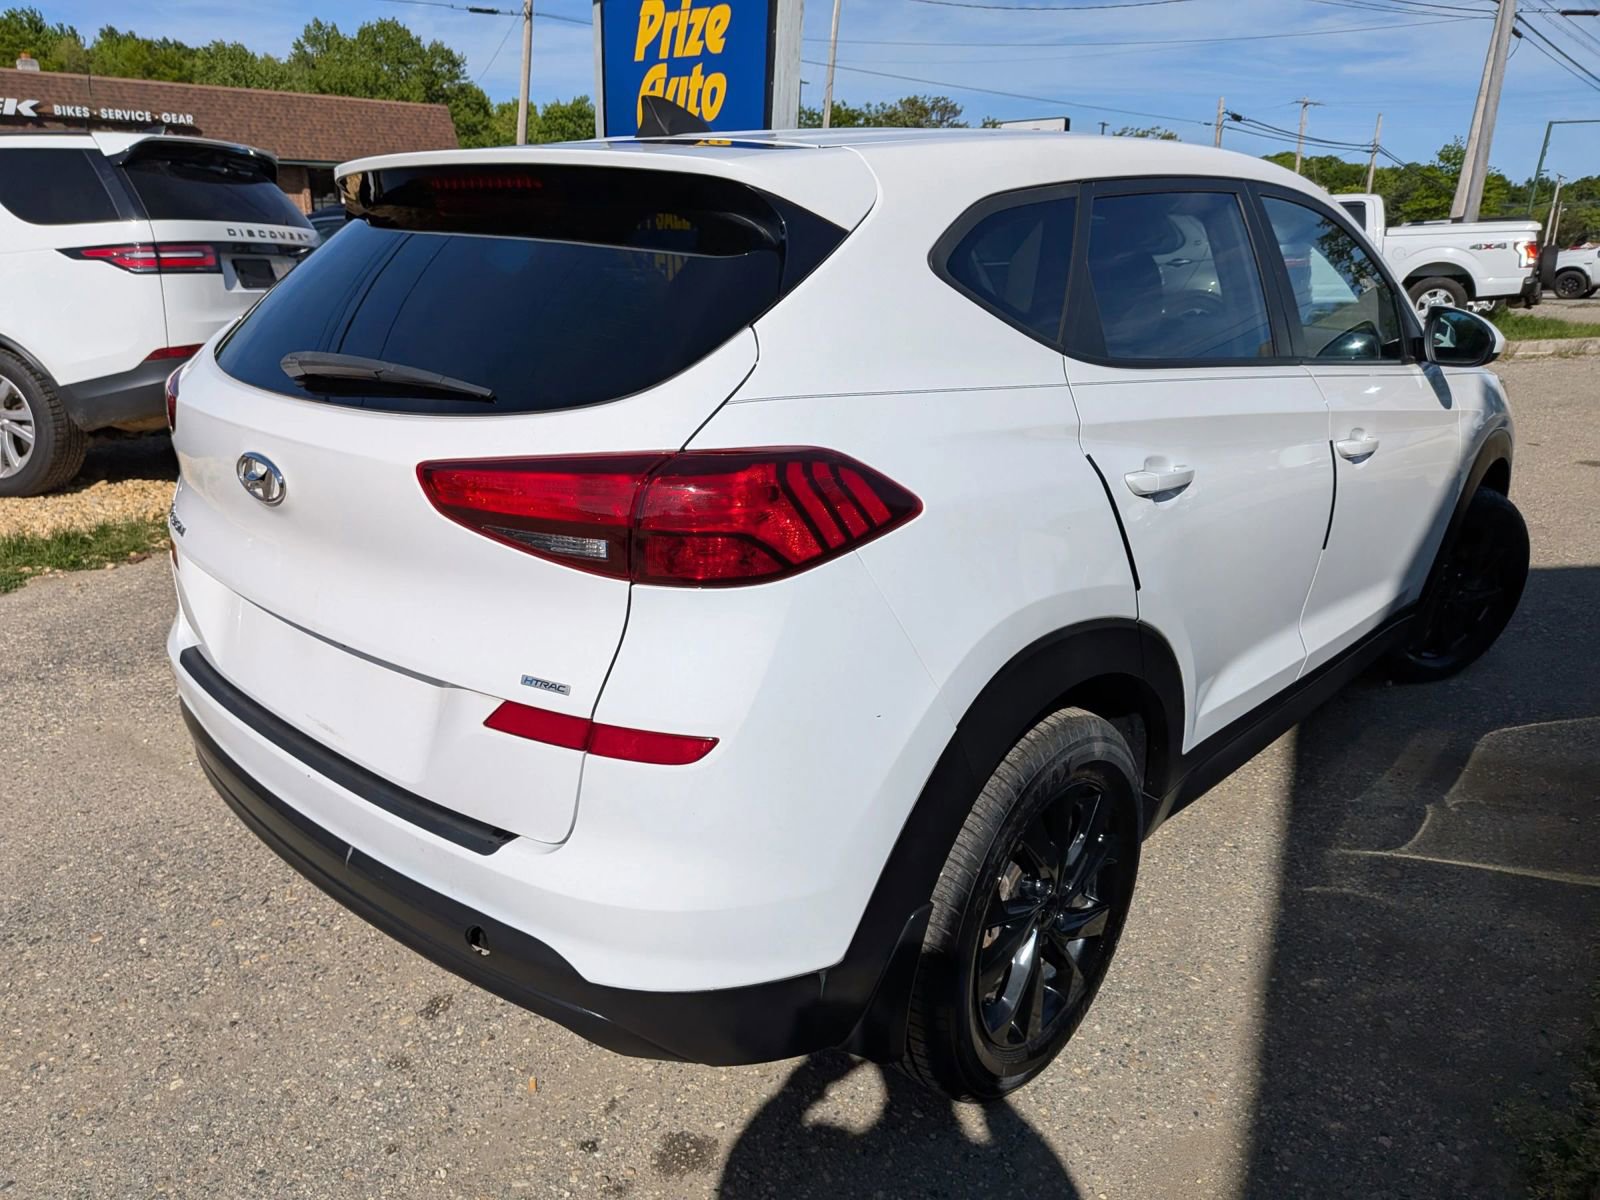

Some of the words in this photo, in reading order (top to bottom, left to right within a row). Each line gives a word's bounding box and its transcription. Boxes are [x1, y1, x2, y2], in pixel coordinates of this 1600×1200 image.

[634, 0, 732, 62] Prize
[636, 62, 727, 129] Auto
[53, 104, 90, 118] BIKES
[100, 108, 152, 122] SERVICE
[161, 112, 194, 125] GEAR
[226, 228, 309, 241] DISCOVERY
[523, 676, 566, 693] HTRAC
